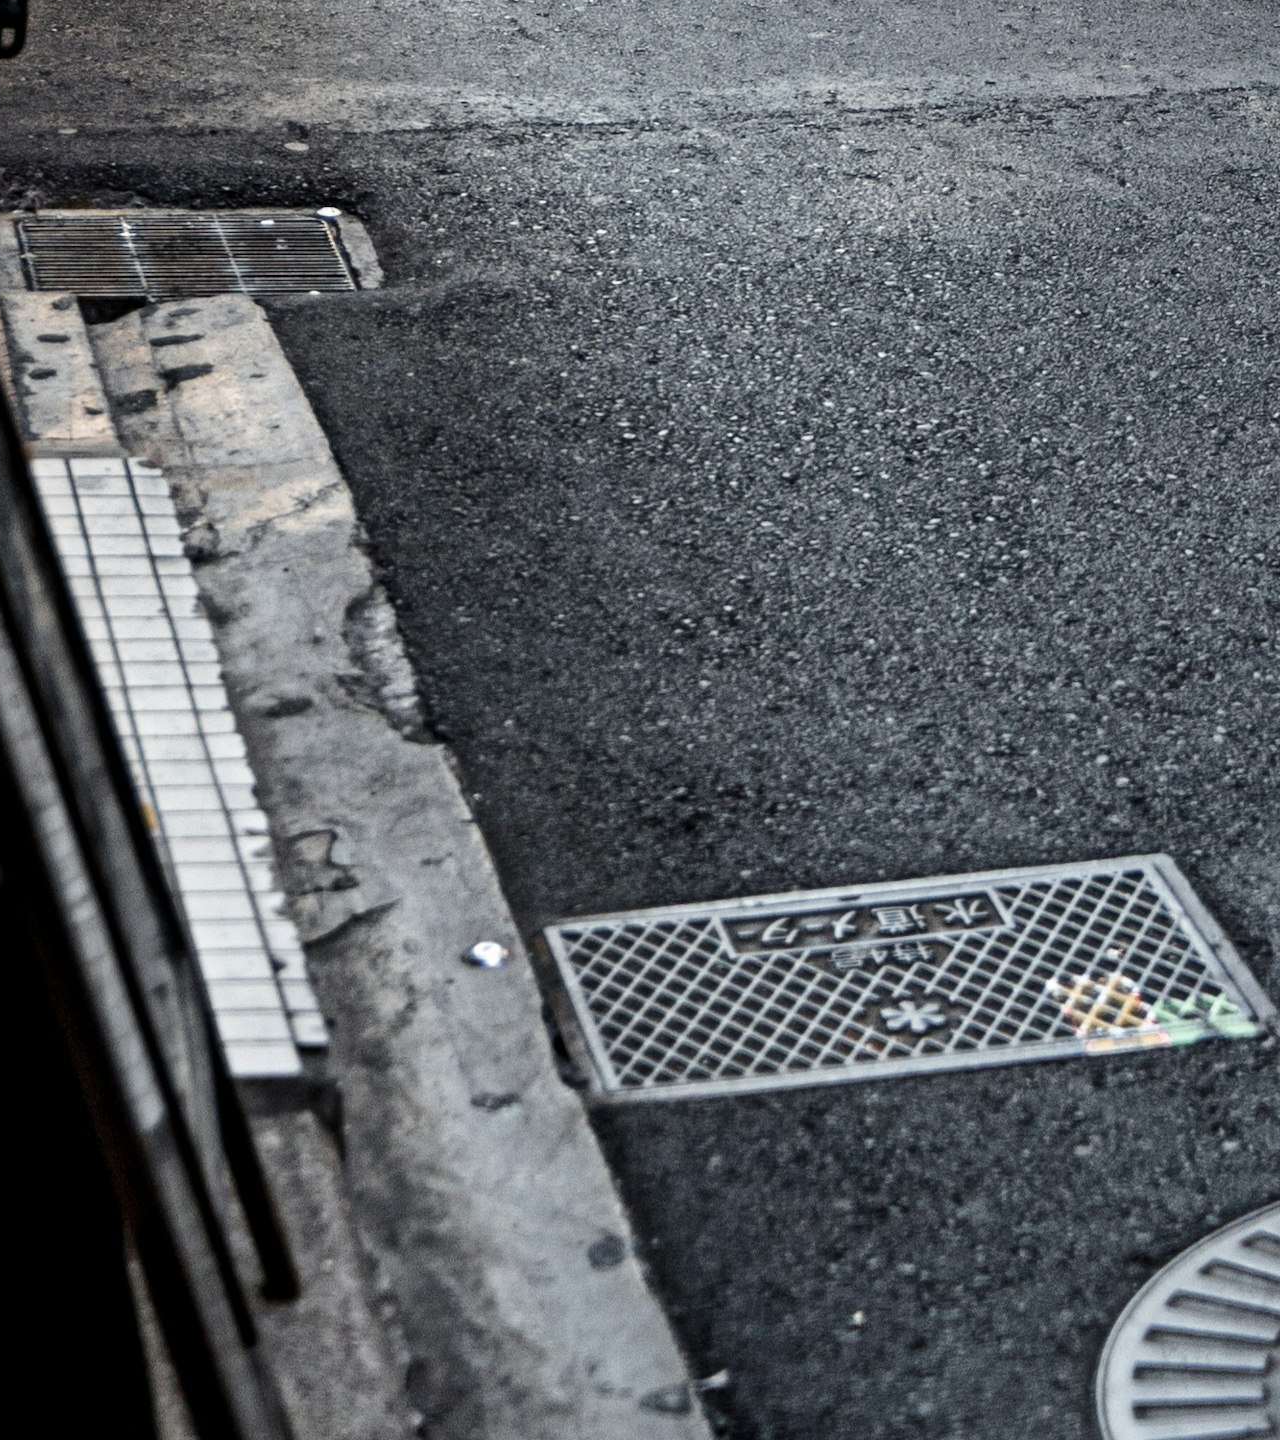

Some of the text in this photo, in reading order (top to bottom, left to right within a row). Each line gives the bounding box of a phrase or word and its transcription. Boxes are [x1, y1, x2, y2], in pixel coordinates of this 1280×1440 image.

[736, 897, 991, 946] 水道メーター
